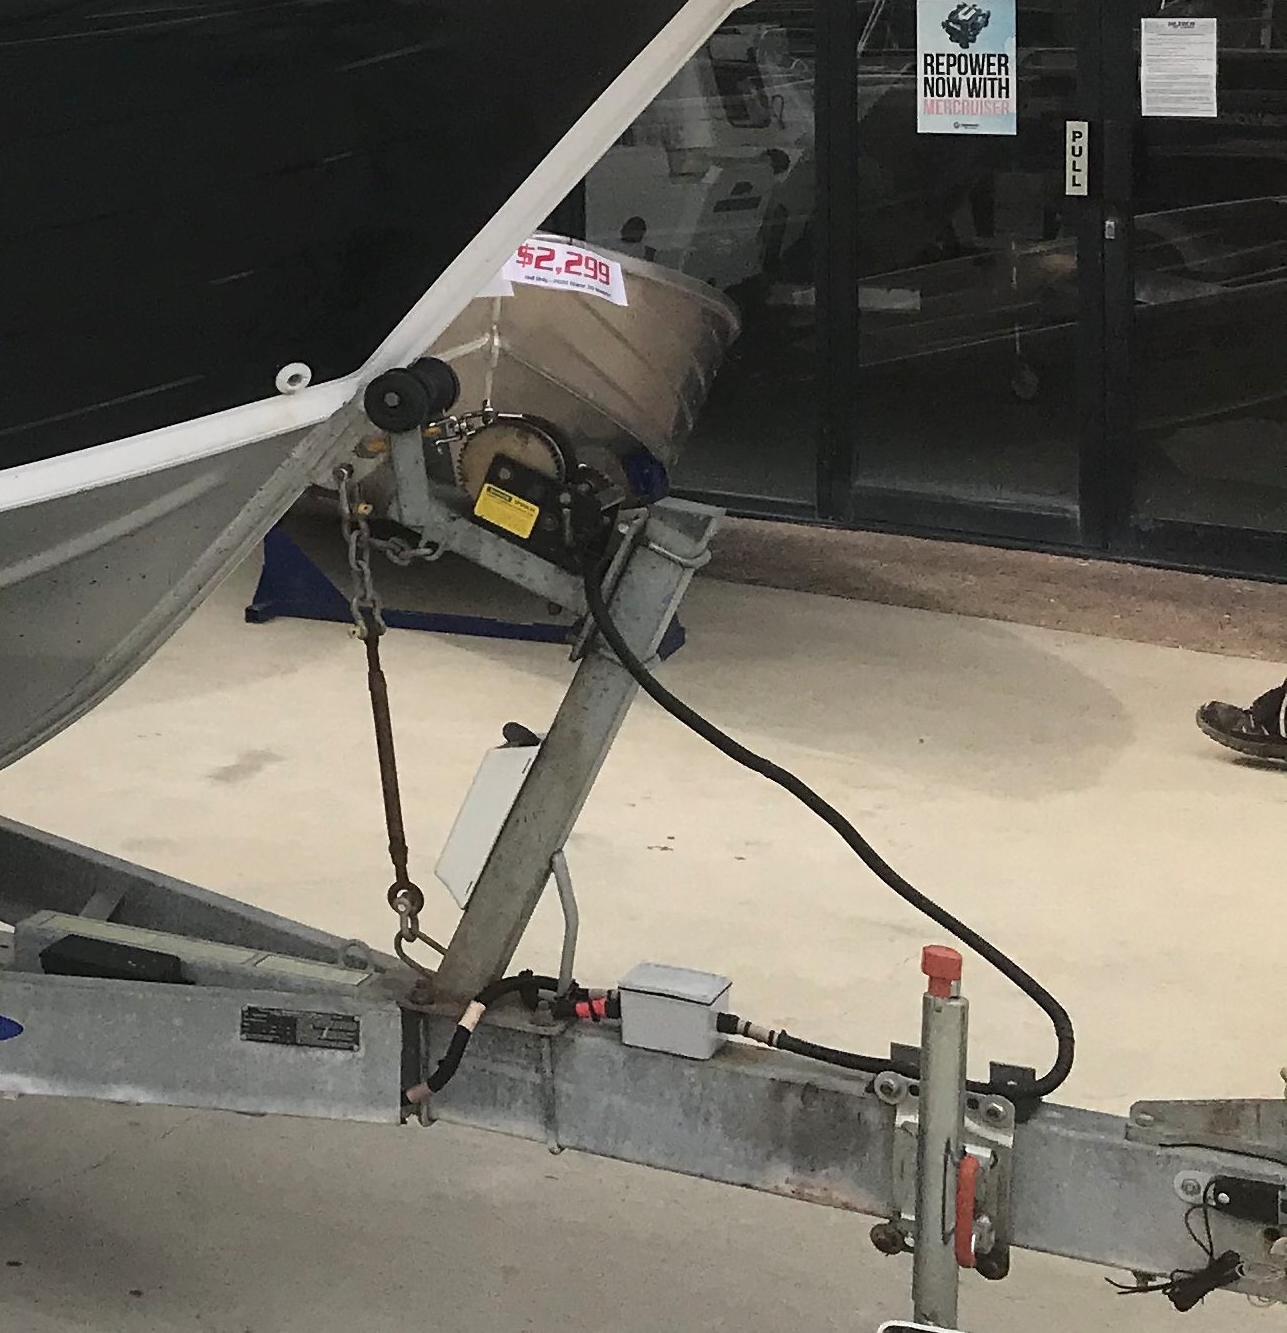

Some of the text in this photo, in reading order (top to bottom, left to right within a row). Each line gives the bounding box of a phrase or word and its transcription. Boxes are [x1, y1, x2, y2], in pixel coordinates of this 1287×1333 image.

[923, 53, 1010, 76] REPOWER
[923, 77, 1010, 99] NOW WITH
[923, 99, 1012, 116] MERCRUISER
[1071, 130, 1083, 187] PULL
[515, 243, 611, 286] $2,299
